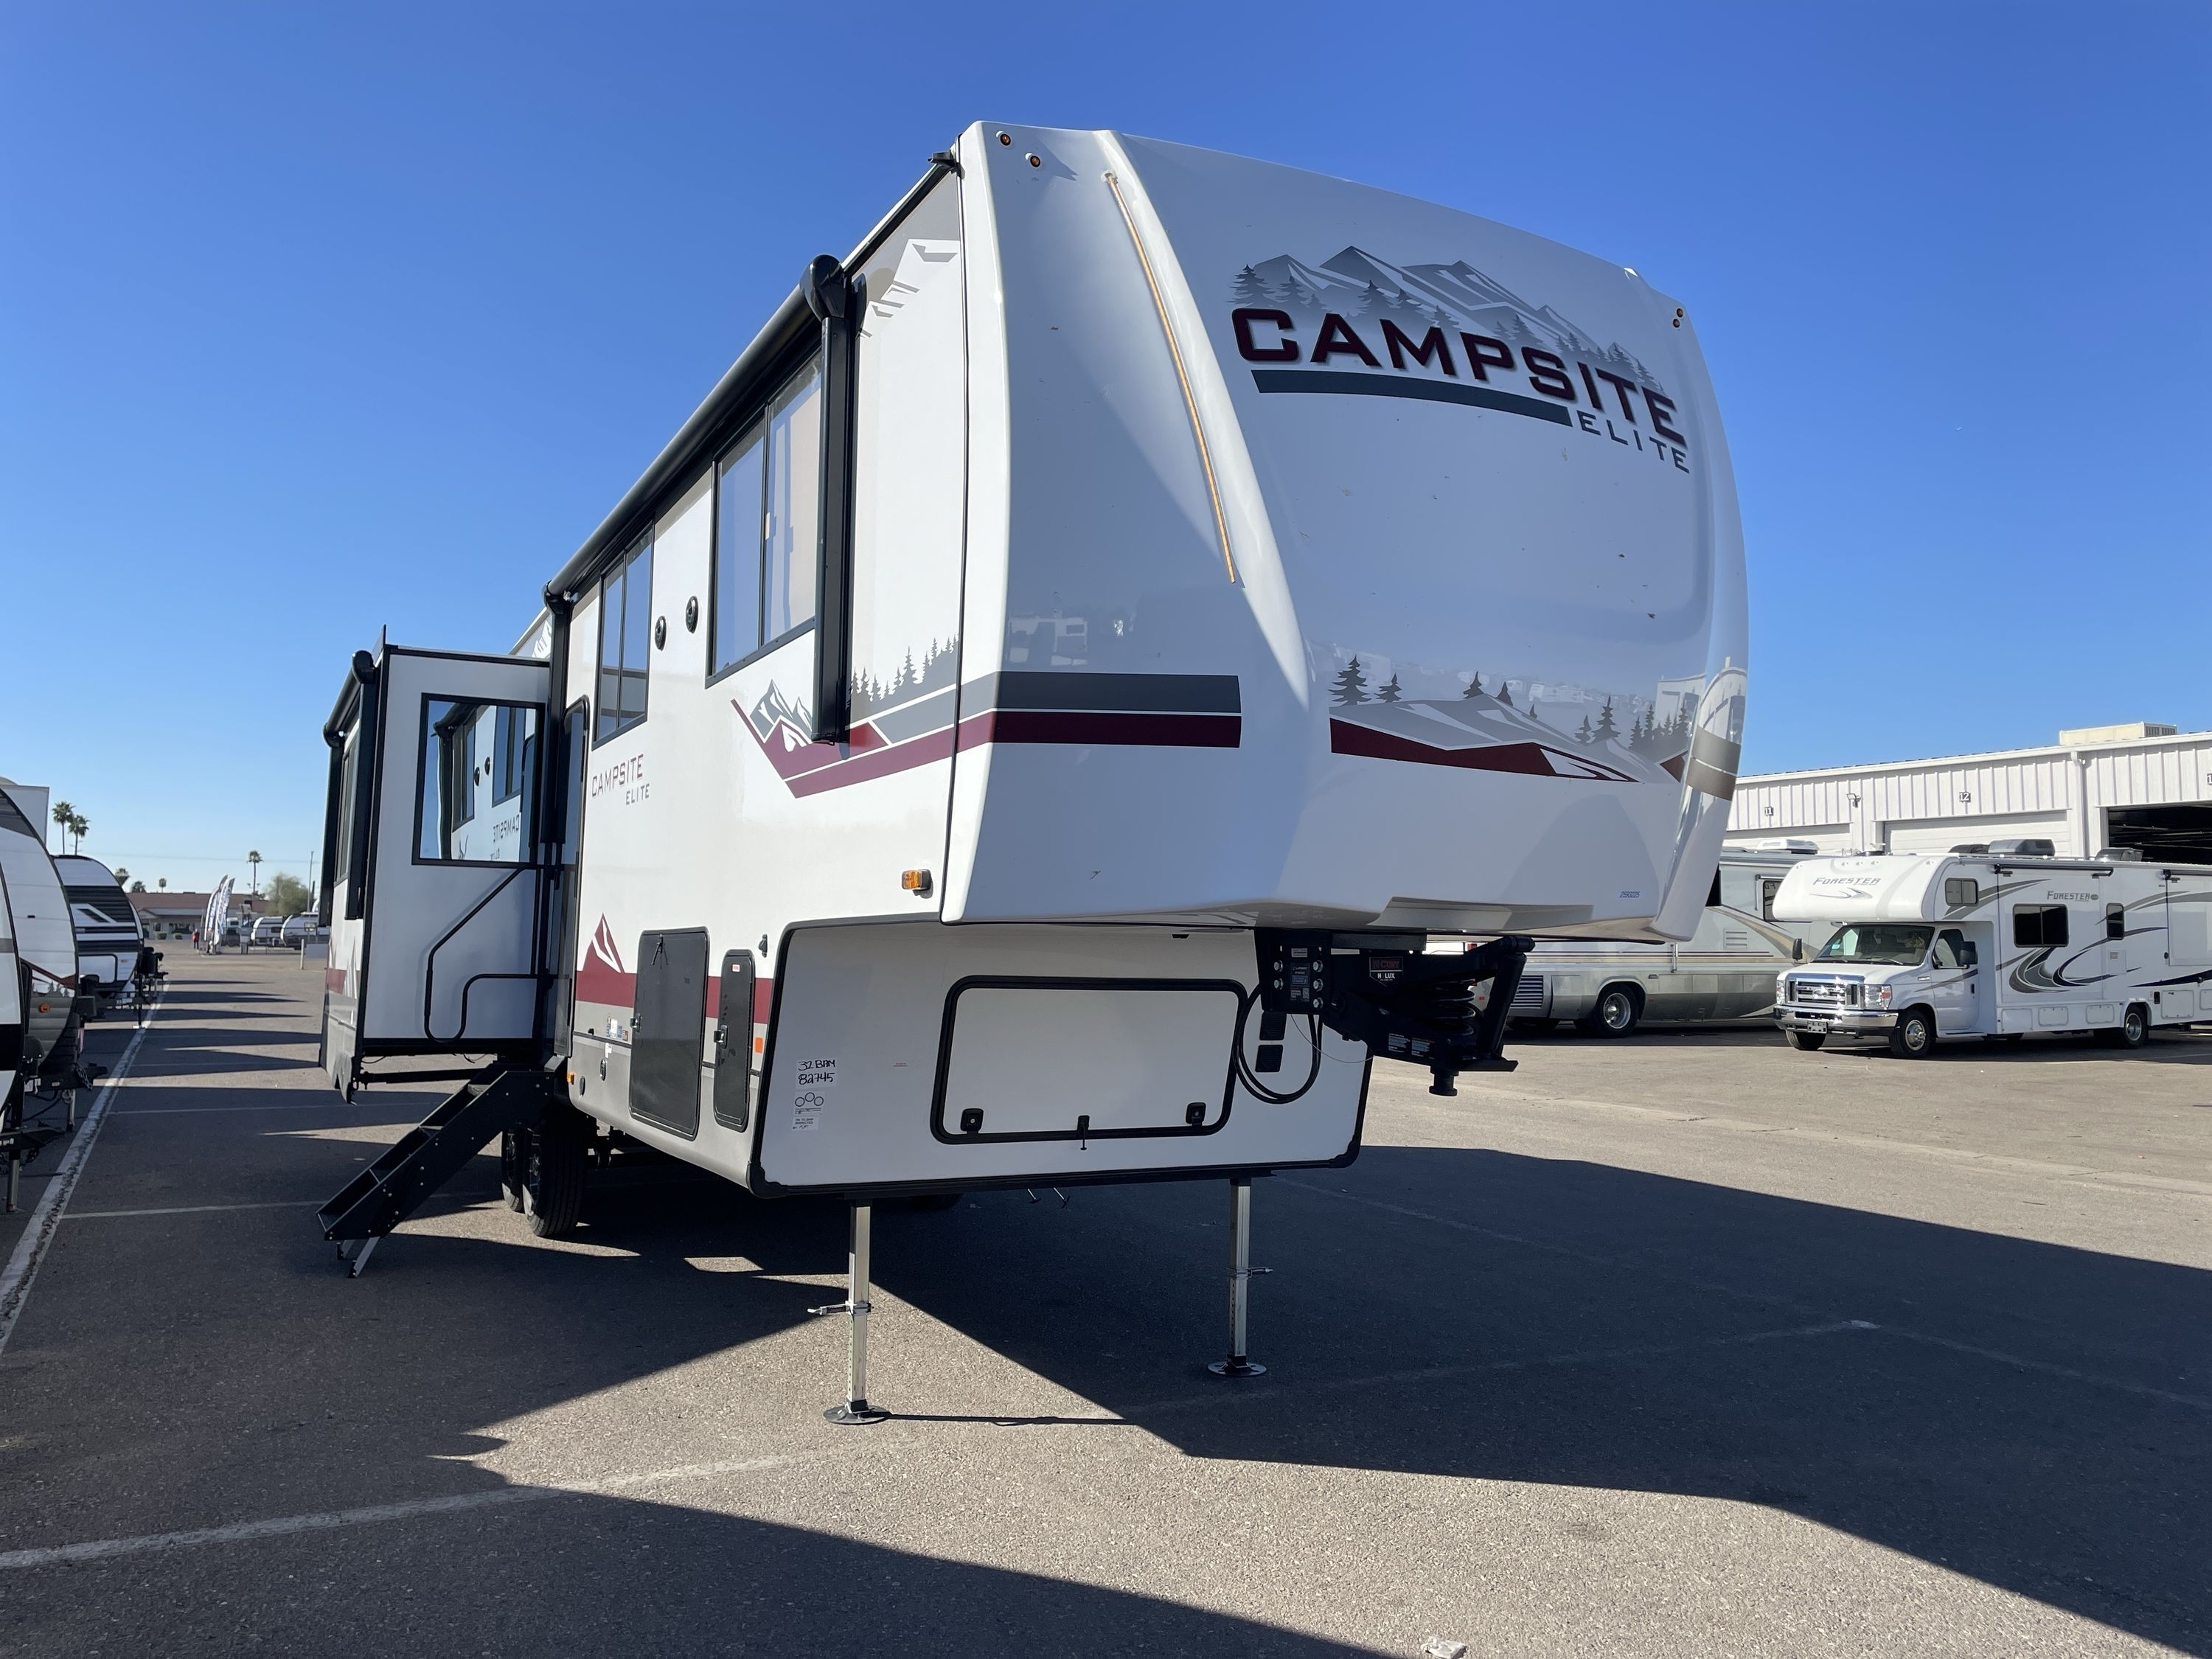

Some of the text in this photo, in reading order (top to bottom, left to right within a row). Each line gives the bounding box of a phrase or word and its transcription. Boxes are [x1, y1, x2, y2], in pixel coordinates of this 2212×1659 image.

[1231, 307, 1687, 448] CAMPSITE
[1576, 409, 1690, 474] ELITE
[591, 754, 644, 797] CAMPSITE
[625, 783, 650, 805] ELITE
[1960, 792, 1970, 801] 12
[1764, 807, 1773, 815] 11
[1812, 877, 1882, 886] FORESTER
[2046, 890, 2091, 902] FORESTER
[798, 1060, 814, 1071] 32
[798, 1071, 835, 1085] 82745
